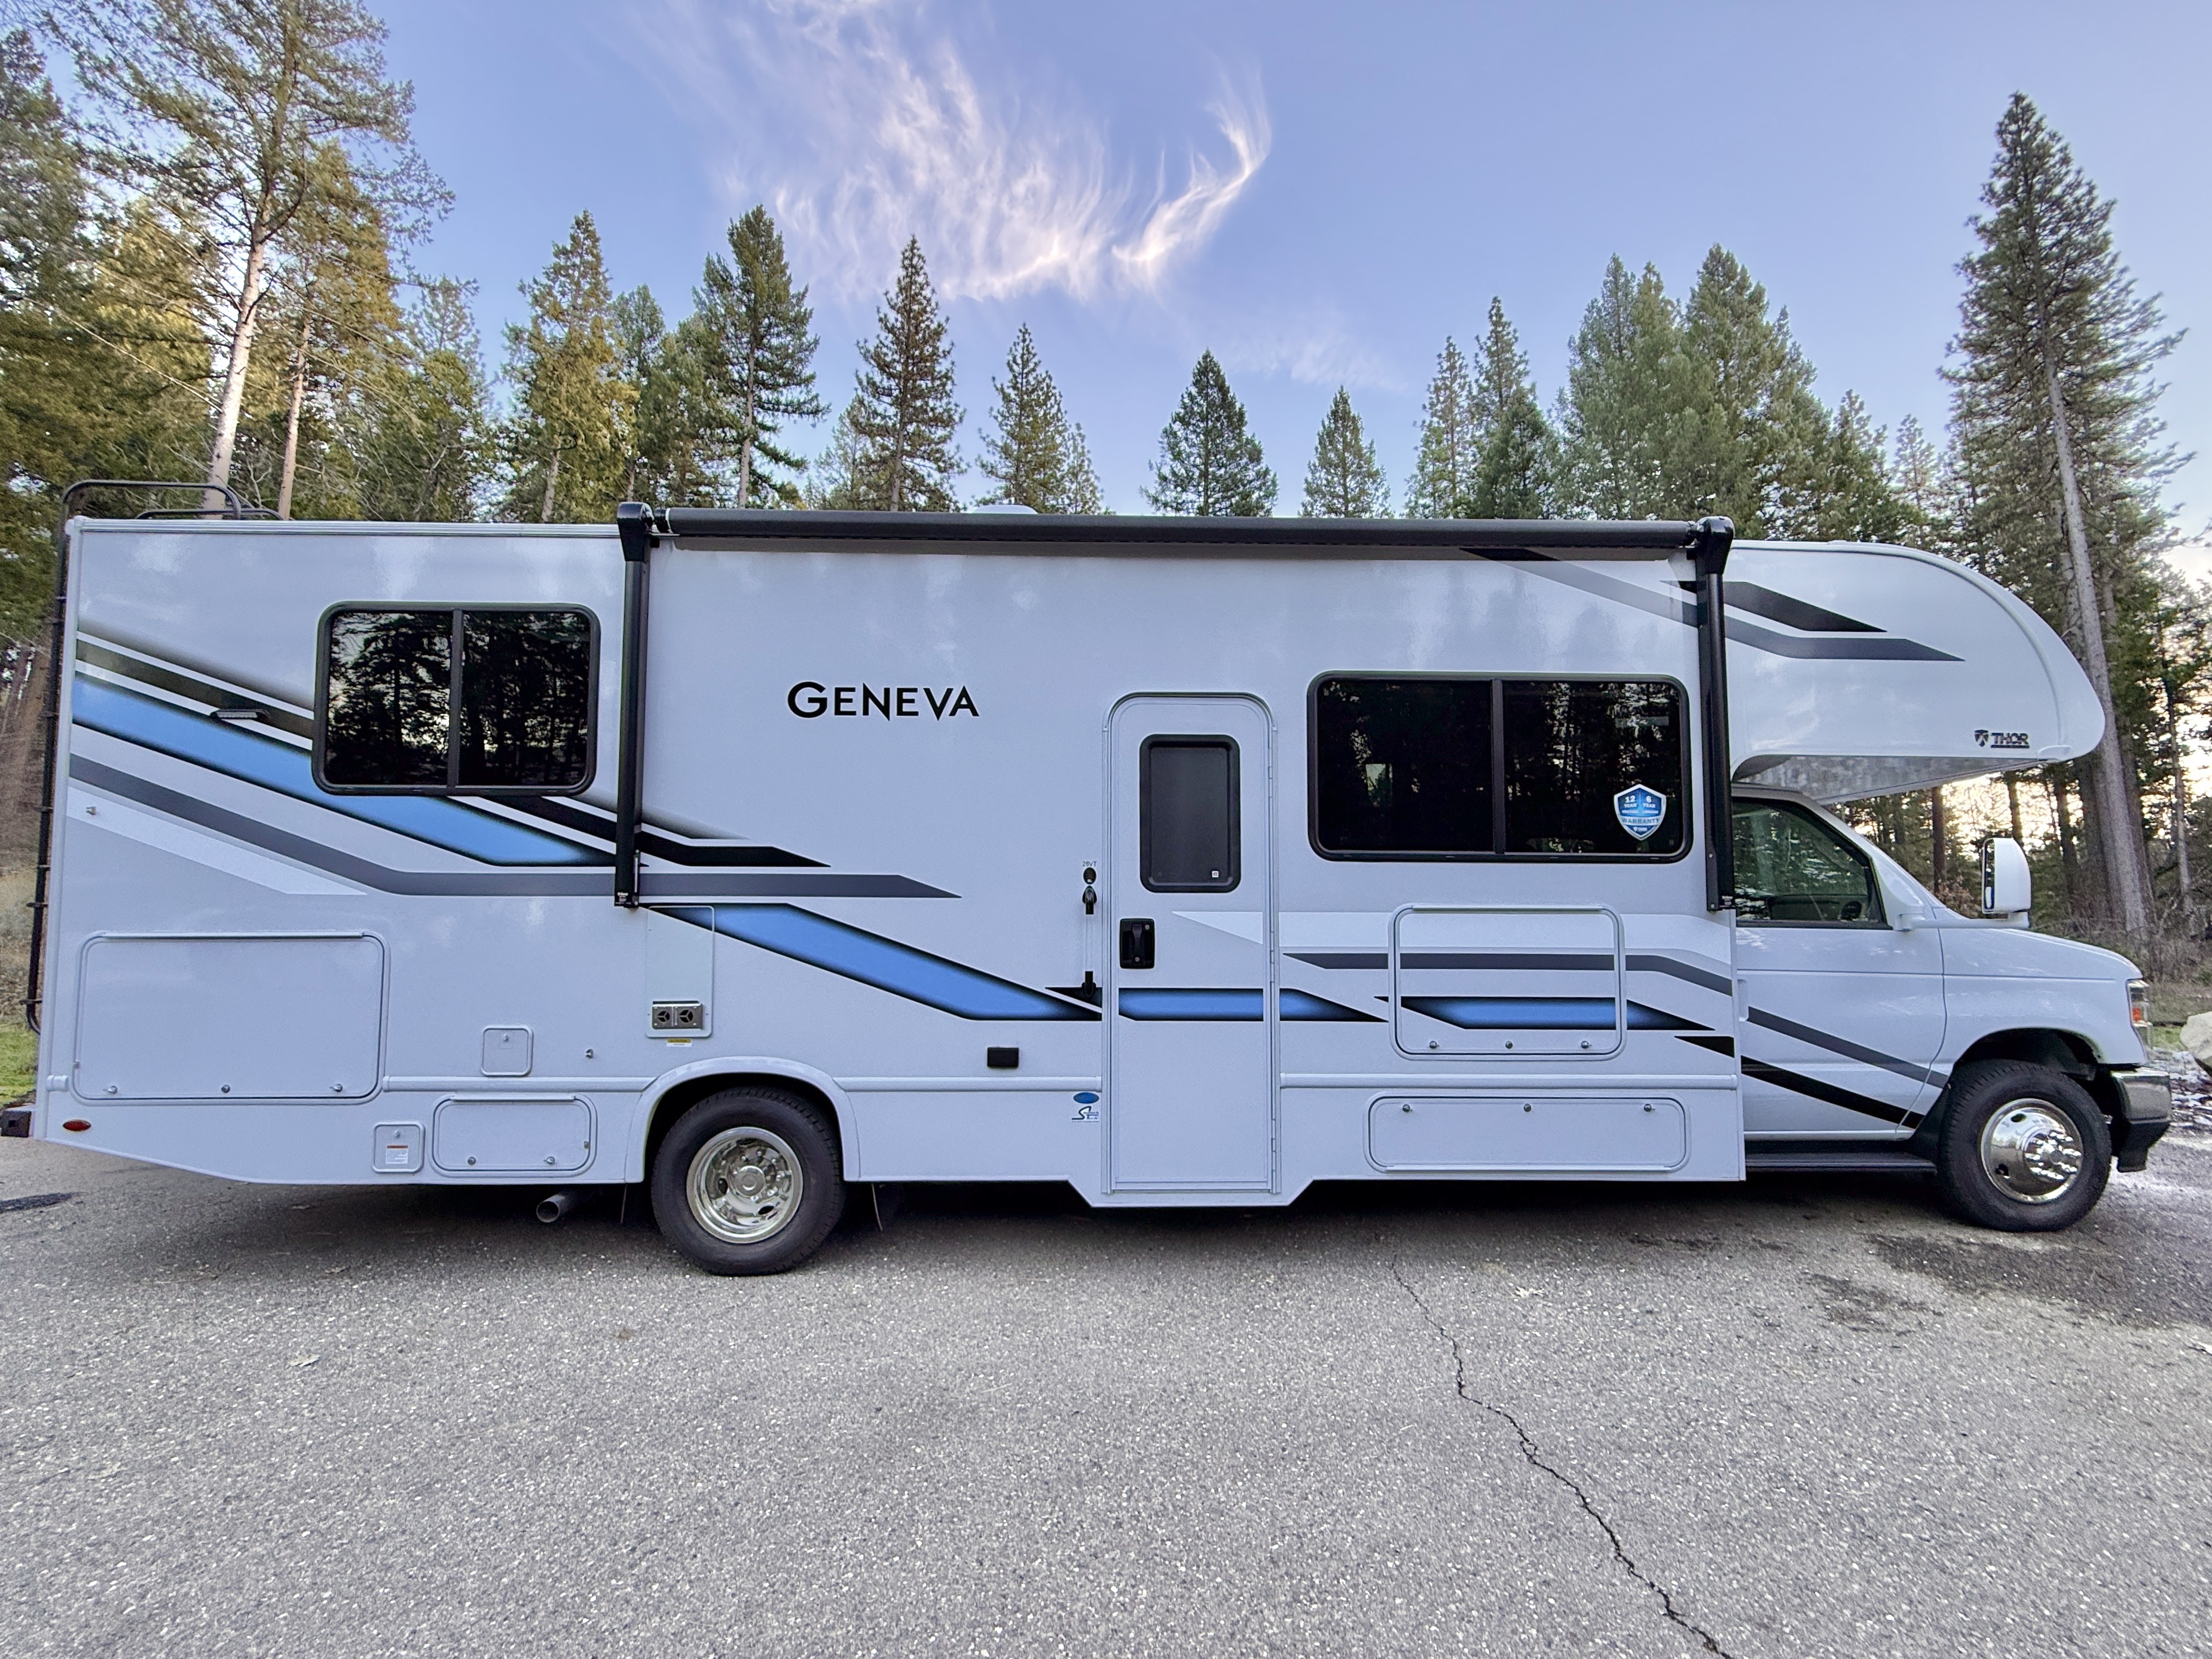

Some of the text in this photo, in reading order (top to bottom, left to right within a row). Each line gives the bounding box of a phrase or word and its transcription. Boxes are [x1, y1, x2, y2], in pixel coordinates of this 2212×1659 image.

[787, 681, 980, 722] GENEVA
[1990, 732, 2029, 745] THOR
[1625, 795, 1636, 803] 12
